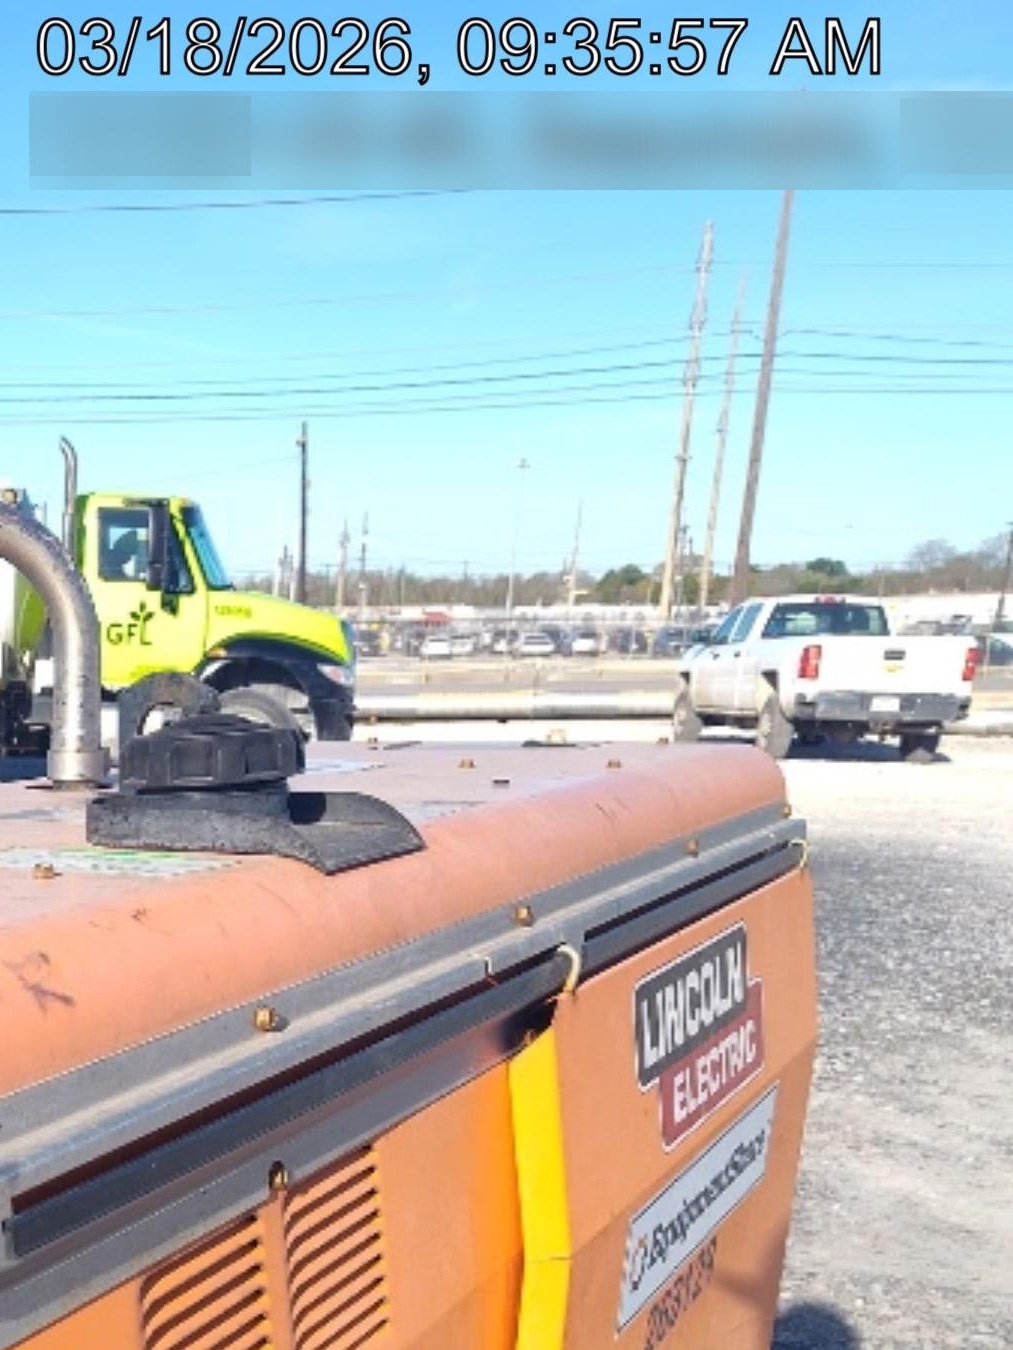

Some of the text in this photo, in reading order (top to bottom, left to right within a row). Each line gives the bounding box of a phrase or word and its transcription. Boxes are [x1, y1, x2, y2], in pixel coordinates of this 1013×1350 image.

[106, 614, 154, 645] GFL
[641, 941, 745, 1069] LINCOLN
[673, 1019, 757, 1126] ELECTRIC
